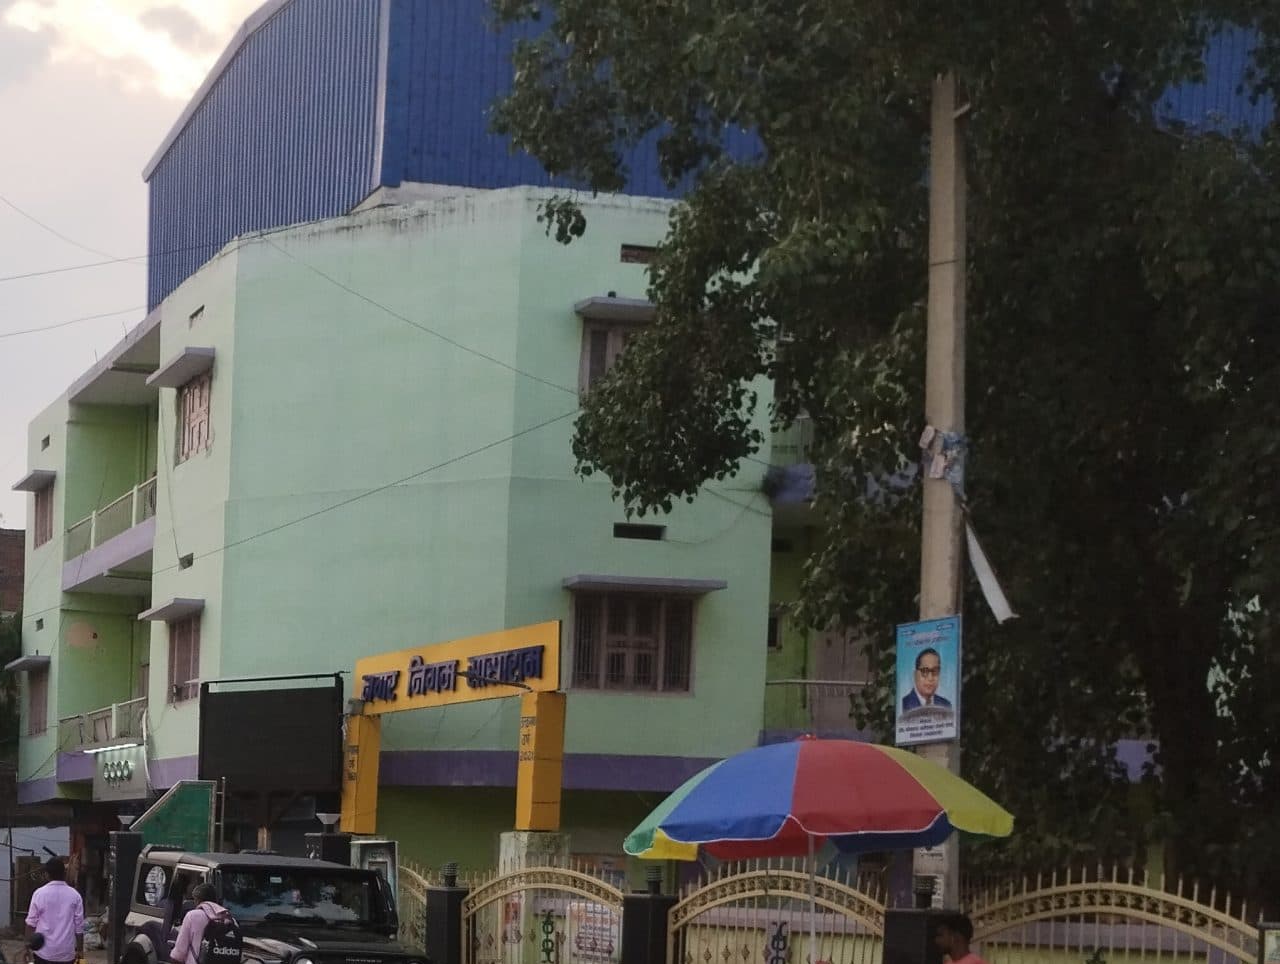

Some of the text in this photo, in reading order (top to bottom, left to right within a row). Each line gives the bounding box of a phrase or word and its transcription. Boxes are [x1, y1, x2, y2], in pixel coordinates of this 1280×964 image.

[361, 644, 546, 703] नगर निगम सासाराम
